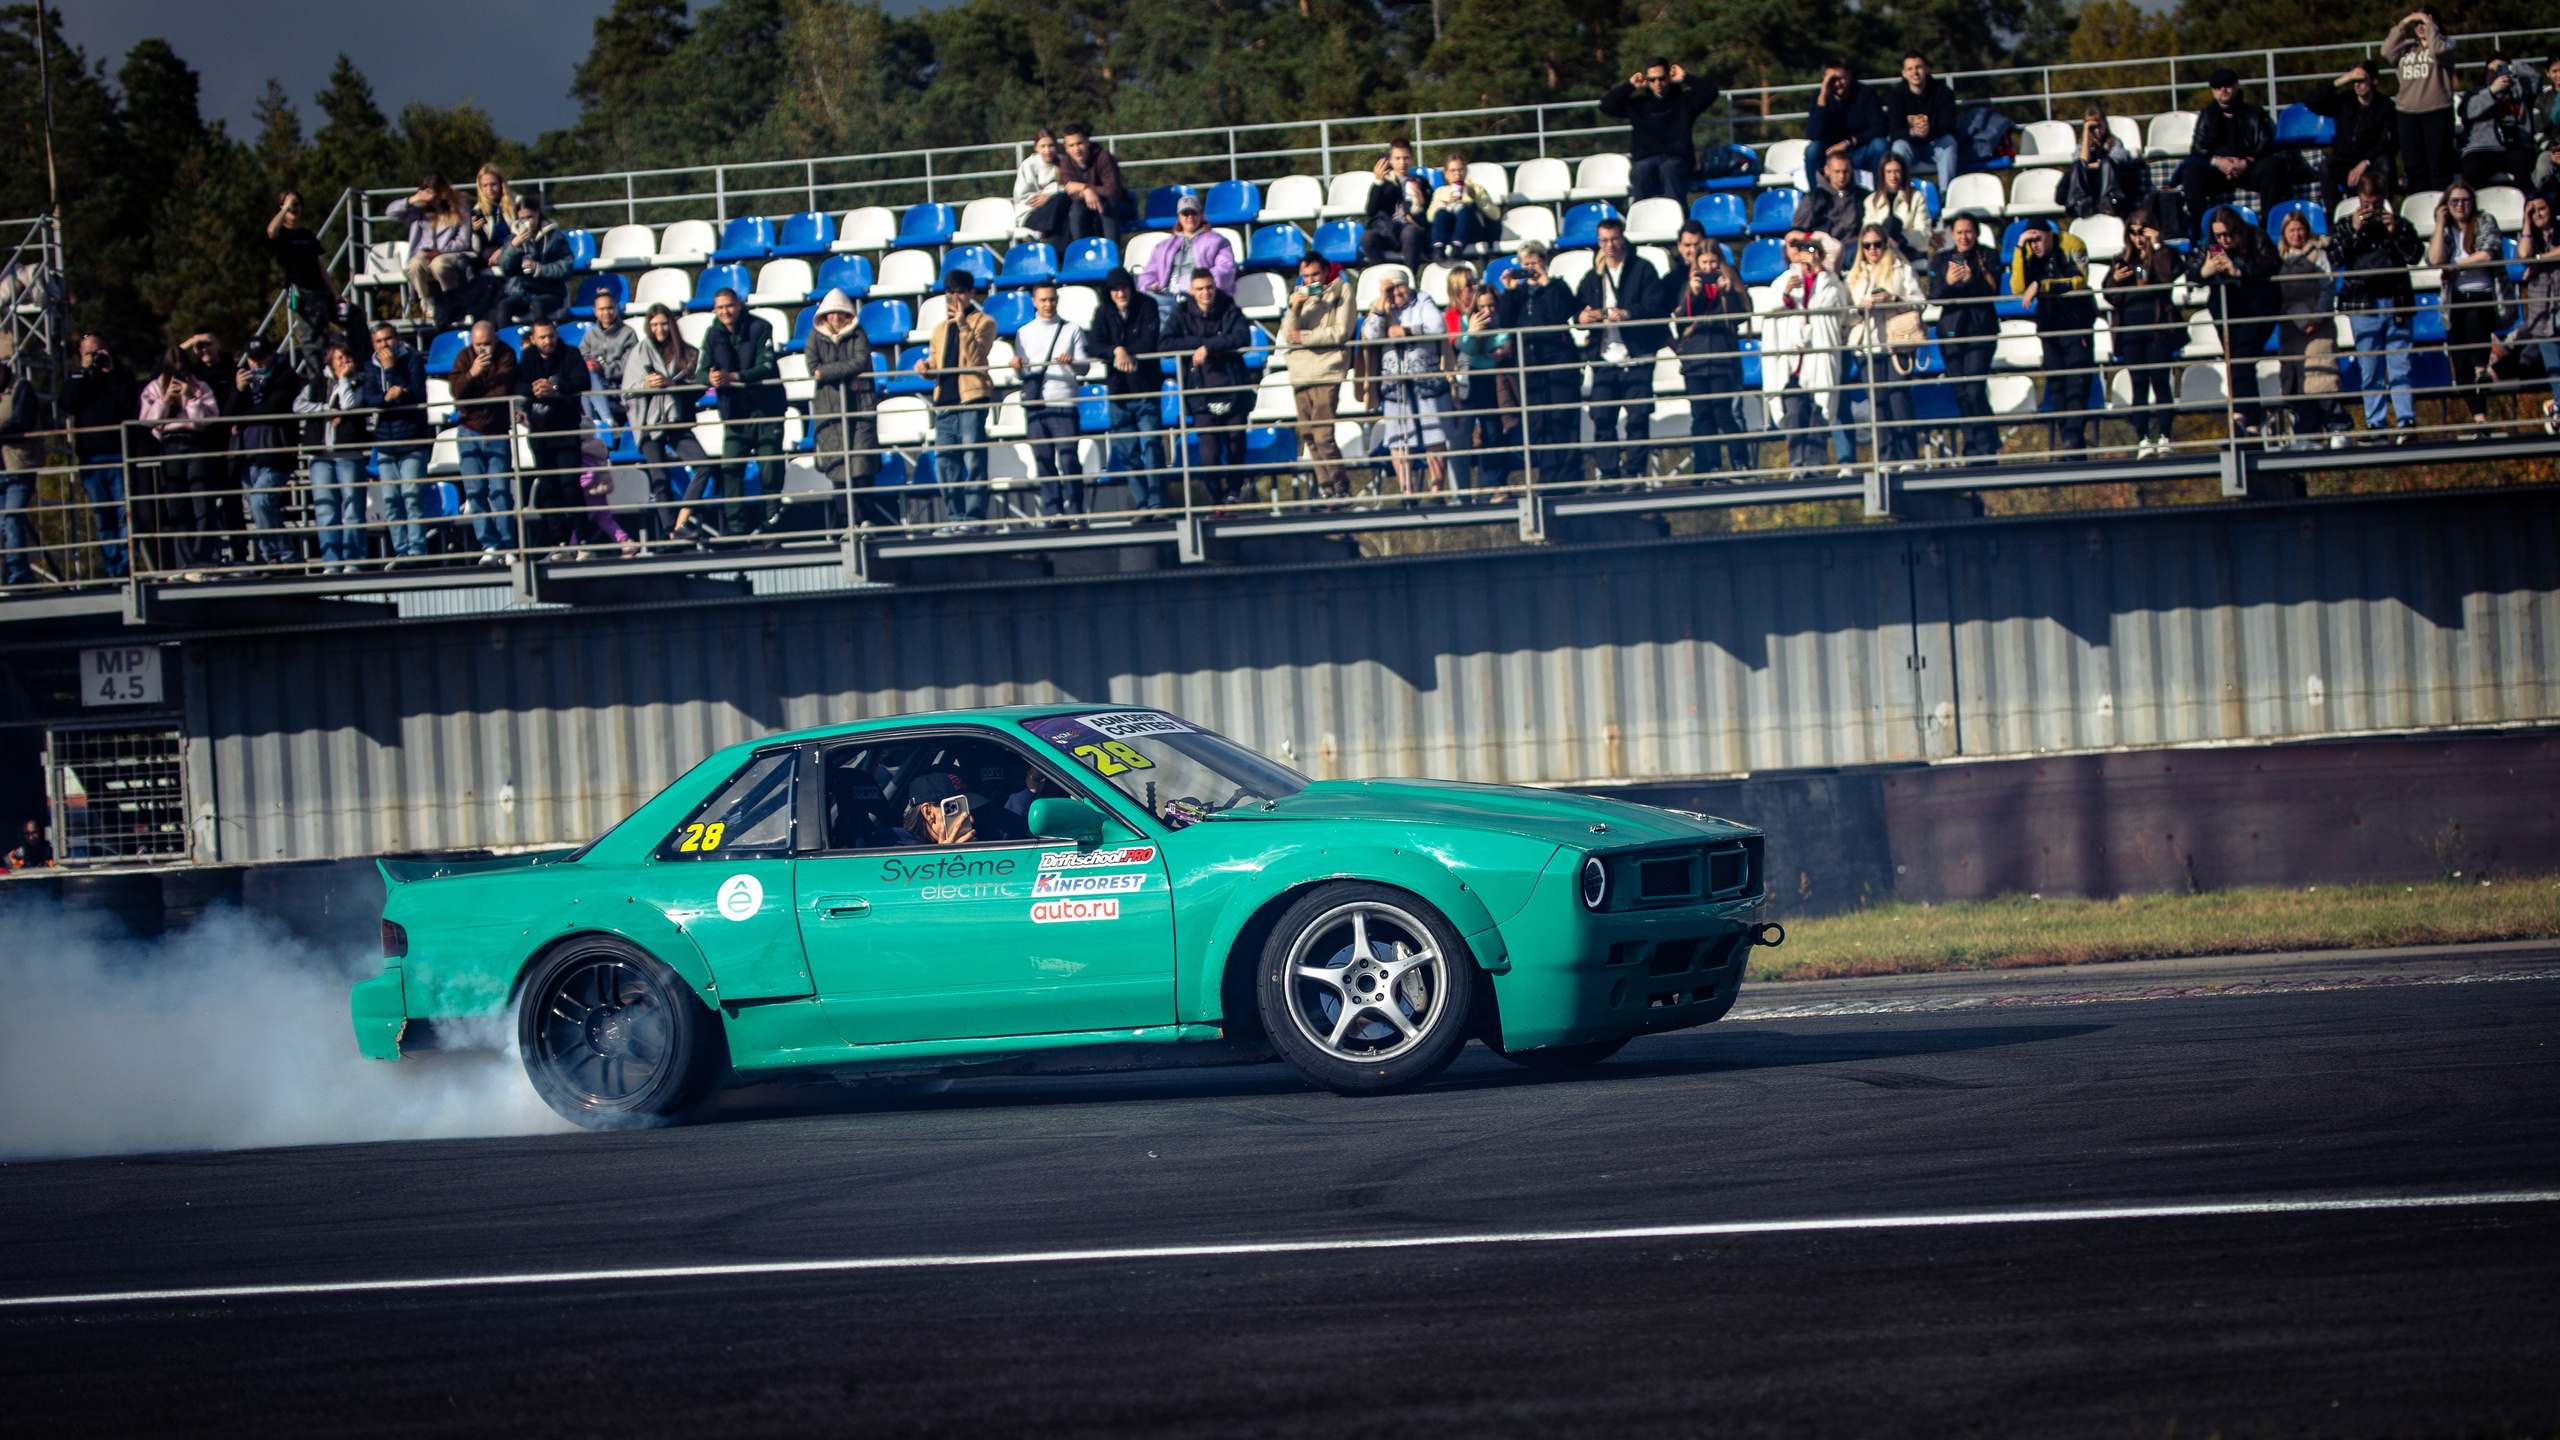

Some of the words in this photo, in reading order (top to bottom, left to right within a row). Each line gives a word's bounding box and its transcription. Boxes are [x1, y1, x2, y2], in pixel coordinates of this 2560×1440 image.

[2402, 63, 2429, 80] 1960
[96, 649, 144, 674] MP
[99, 675, 144, 700] 4.5
[1089, 713, 1127, 727] ADM
[1123, 712, 1165, 724] DRIFT
[1105, 721, 1182, 736] CONTEST
[1072, 740, 1155, 777] 28
[679, 821, 726, 853] 28
[1040, 847, 1154, 869] Driftschool.PRO
[880, 855, 1016, 887] Système
[921, 879, 1014, 900] electric
[1035, 873, 1143, 893] KINFOREST
[1033, 902, 1116, 920] auto.ru
